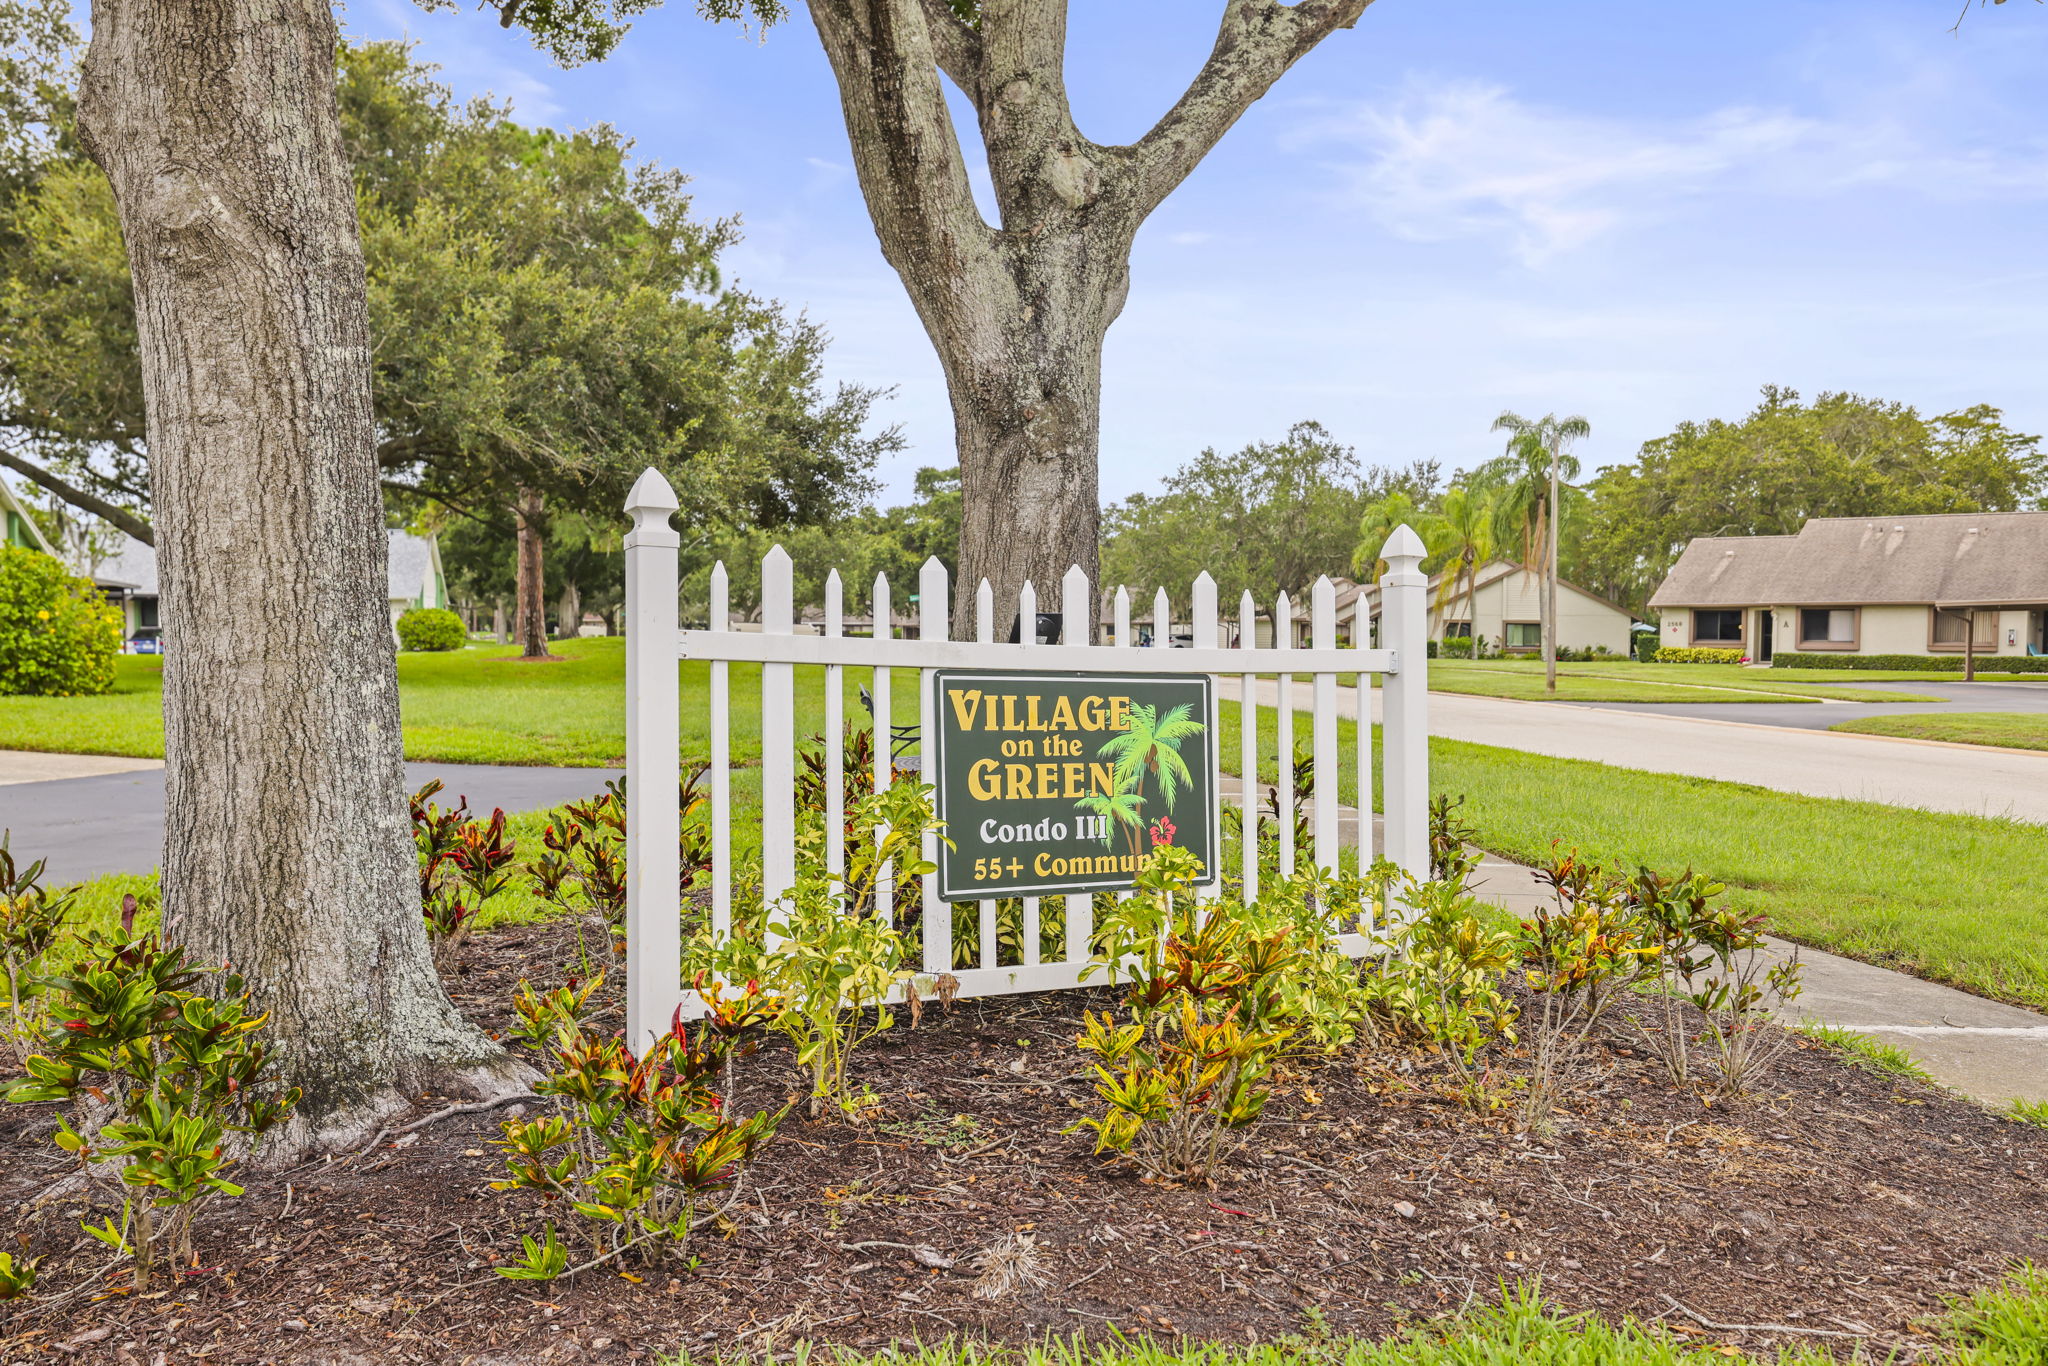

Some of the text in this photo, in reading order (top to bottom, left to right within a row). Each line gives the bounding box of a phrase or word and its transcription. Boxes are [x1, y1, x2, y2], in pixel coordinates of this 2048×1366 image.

[948, 689, 1132, 732] VILLAGE
[1001, 734, 1083, 757] on the
[968, 758, 1115, 801] GREEN
[979, 815, 1108, 843] Condo III
[974, 852, 1152, 881] 55+ Commun
